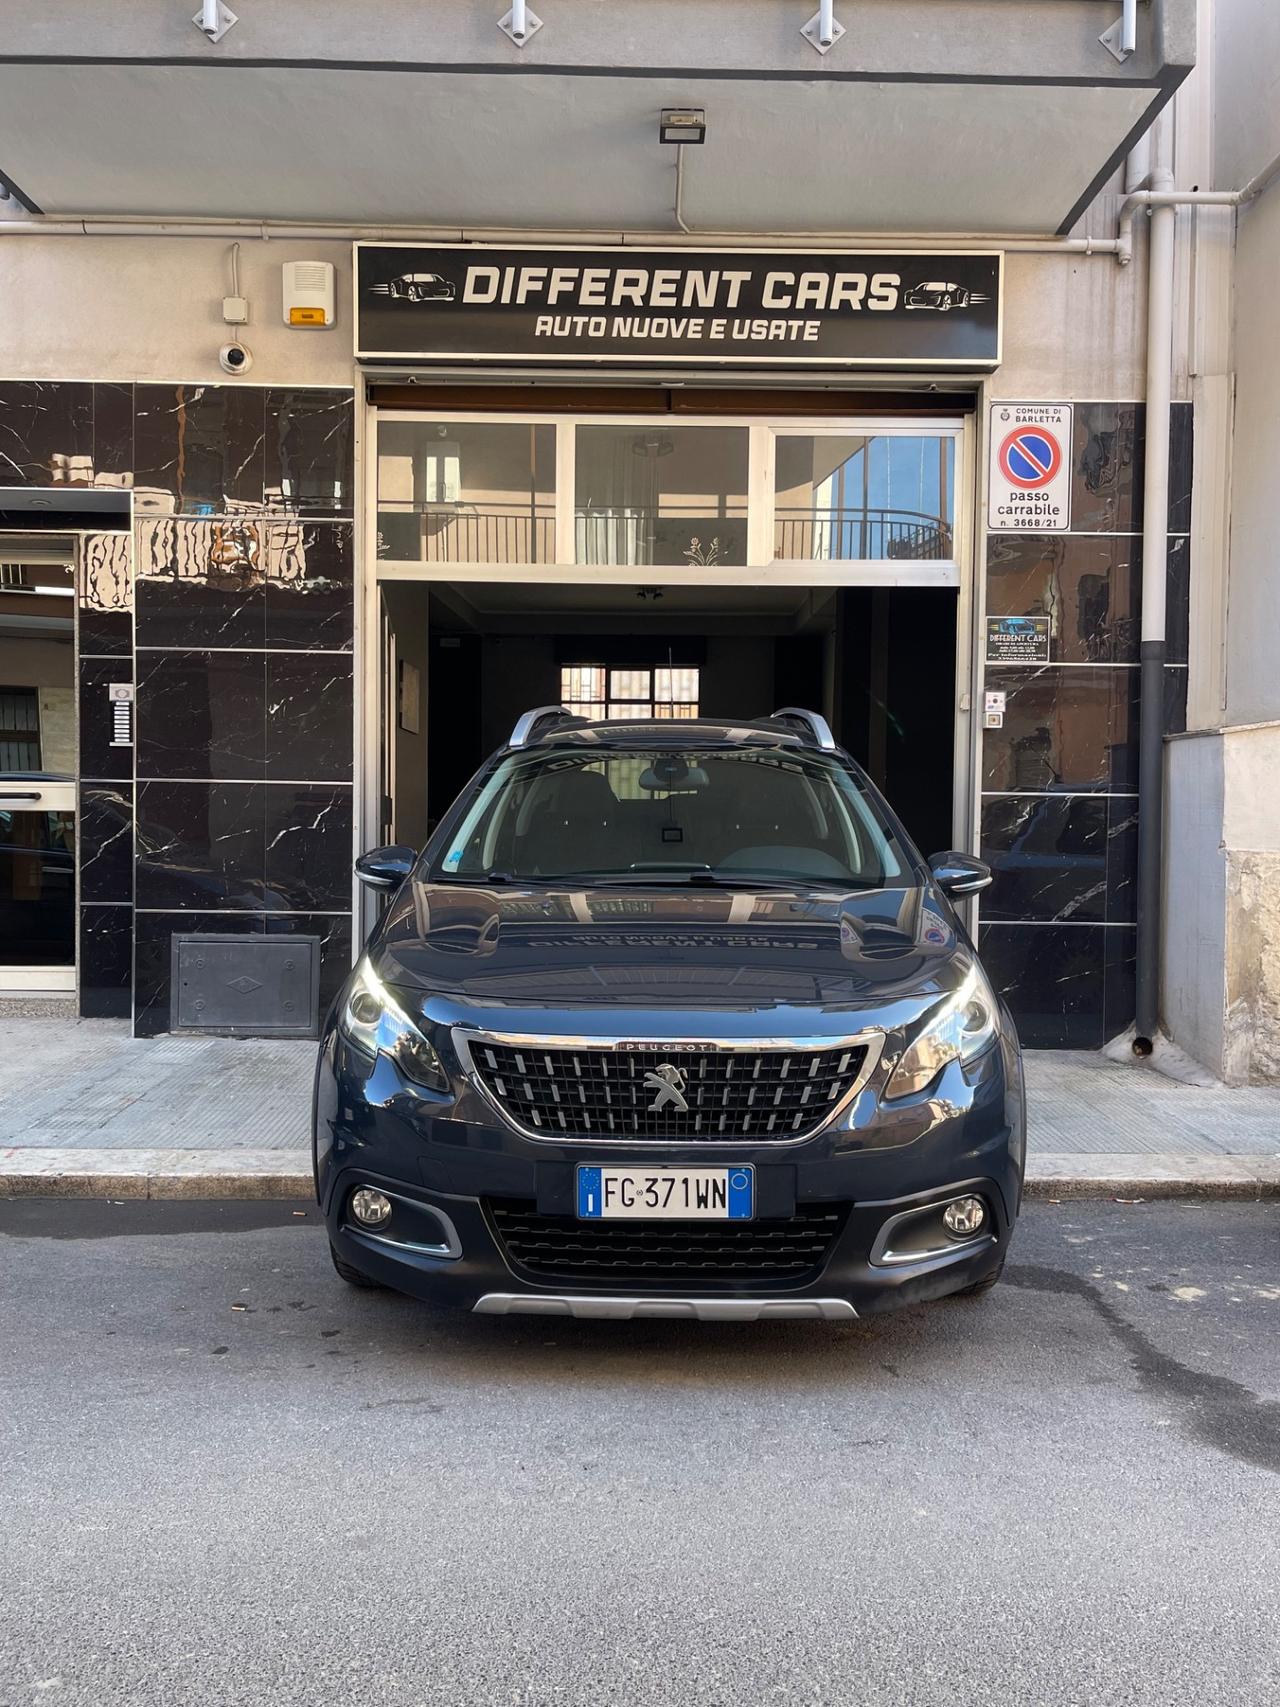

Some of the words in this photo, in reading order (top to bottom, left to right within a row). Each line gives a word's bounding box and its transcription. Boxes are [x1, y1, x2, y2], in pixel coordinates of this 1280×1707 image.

[462, 266, 752, 307] DIFFERENT
[761, 271, 901, 311] CARS
[535, 315, 606, 337] AUTO
[611, 316, 705, 340] NUOVE
[709, 318, 728, 340] E
[731, 319, 822, 342] USATE
[1010, 492, 1050, 503] passo
[997, 504, 1060, 516] carrabile
[1014, 519, 1057, 527] 3668/21
[989, 634, 1026, 642] DIFFERENT
[1026, 634, 1047, 642] CARS
[626, 1043, 708, 1051] PEUGEOT
